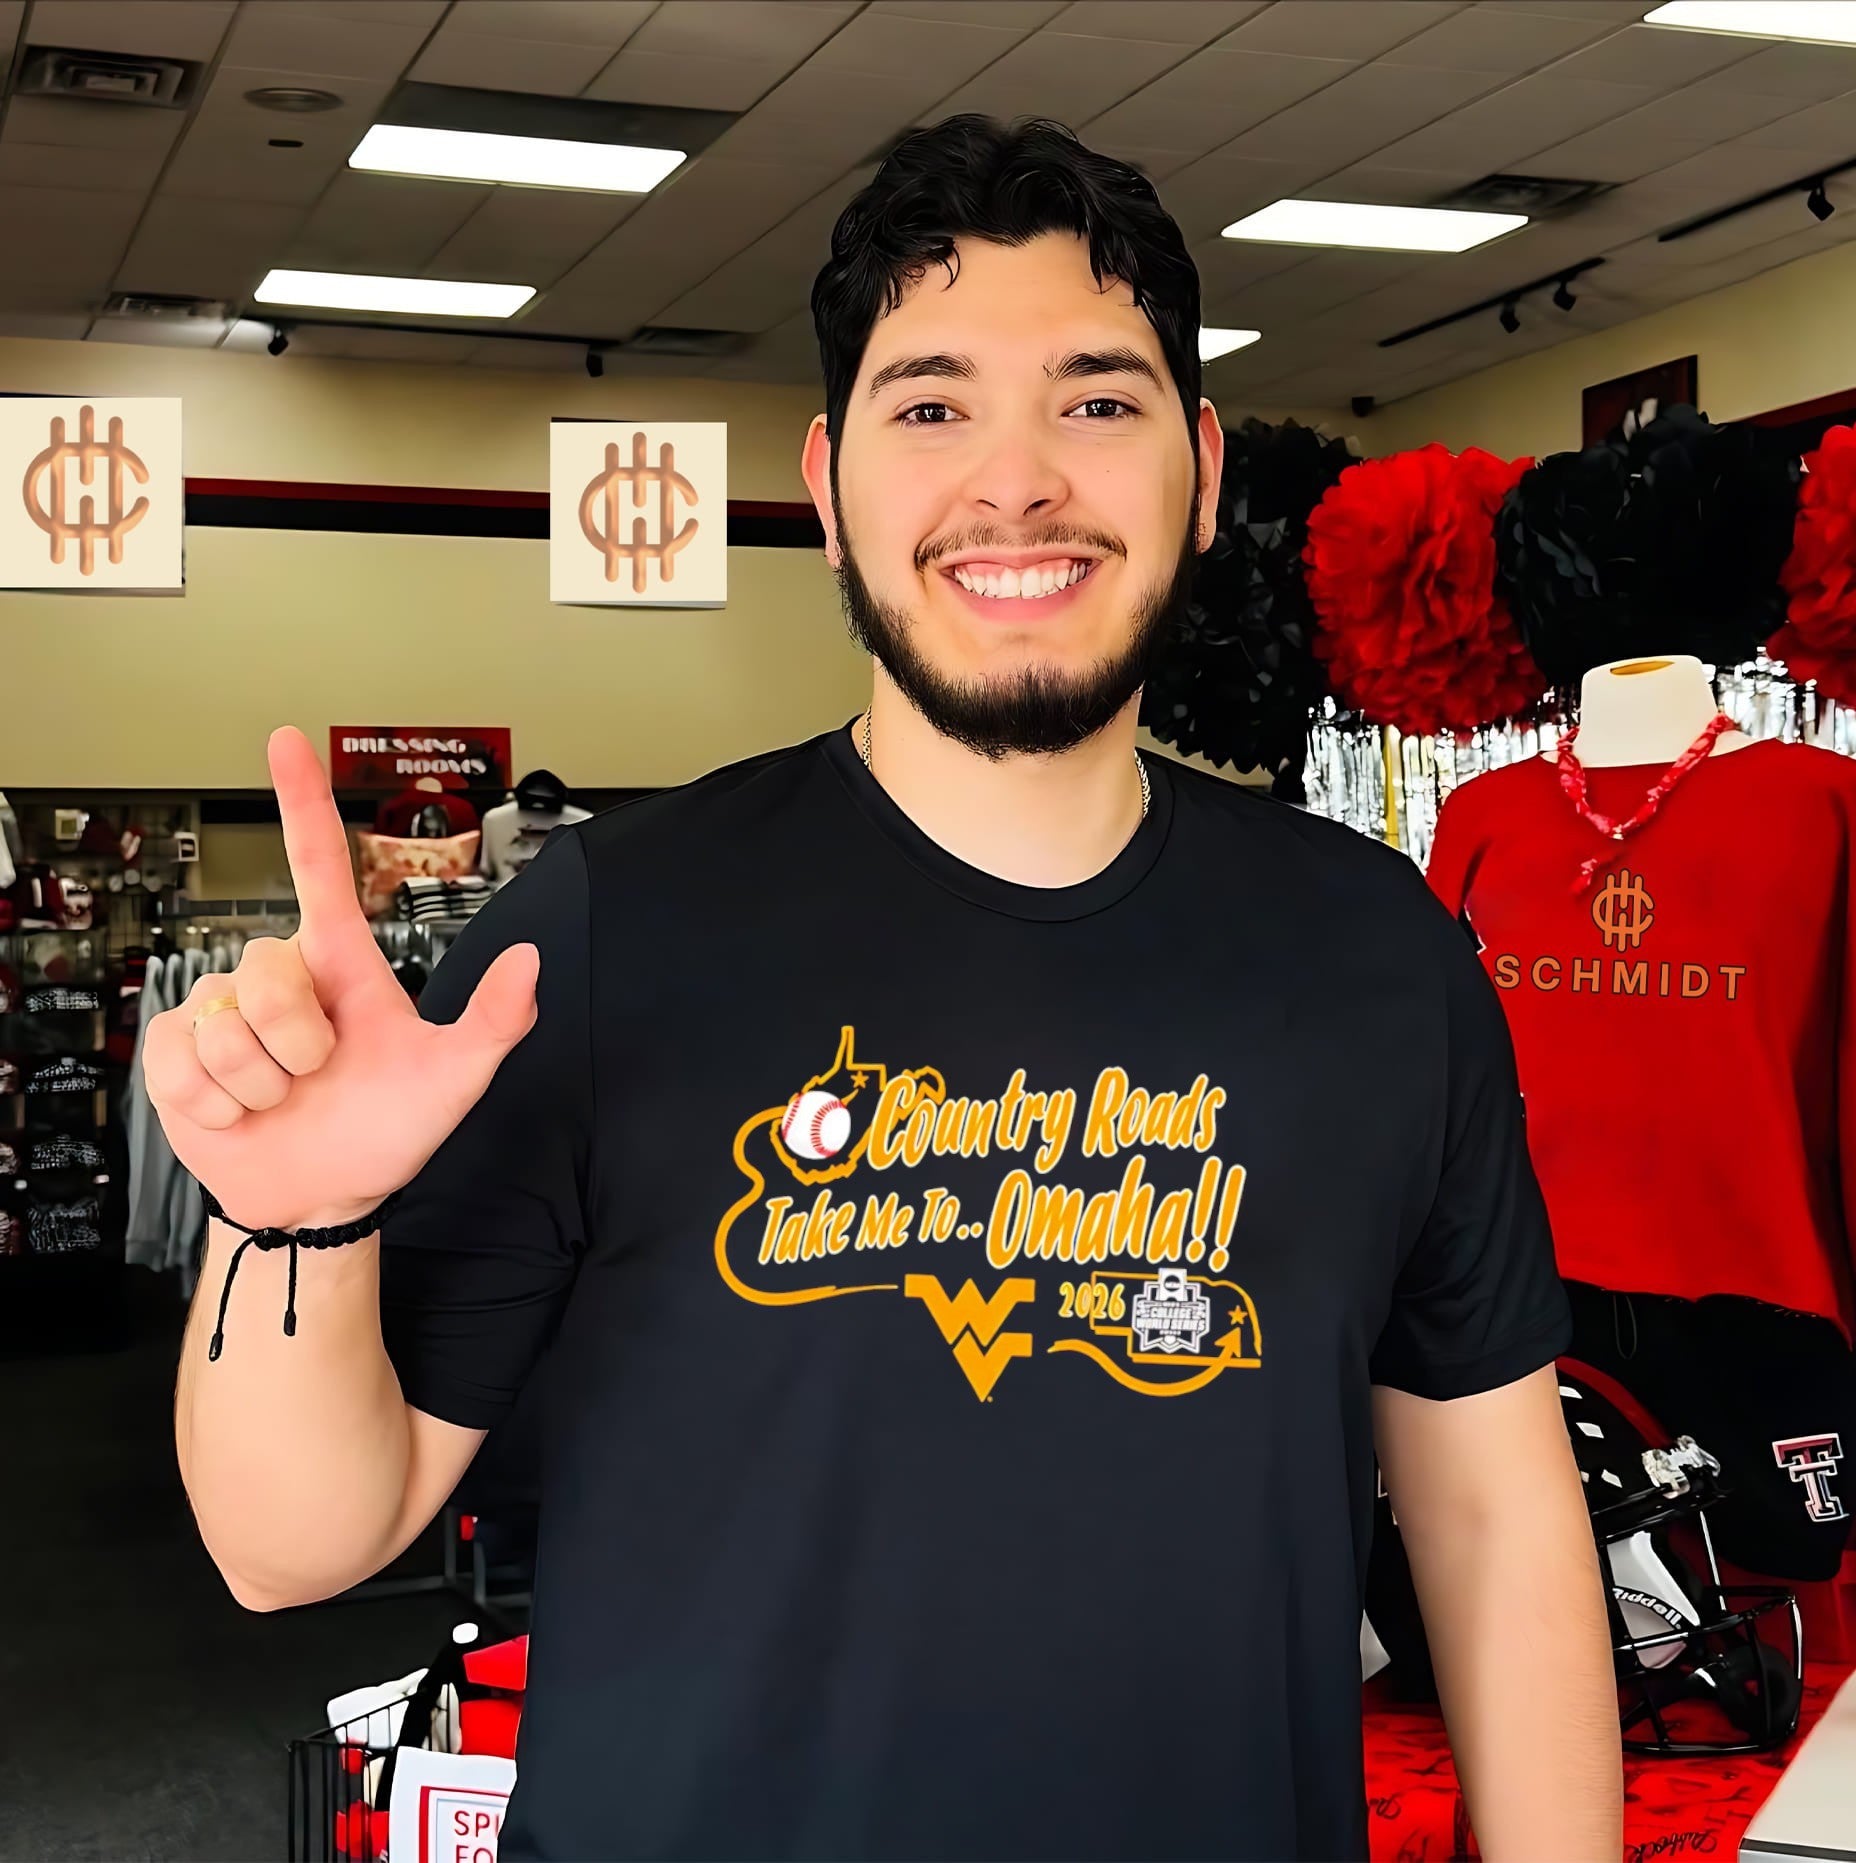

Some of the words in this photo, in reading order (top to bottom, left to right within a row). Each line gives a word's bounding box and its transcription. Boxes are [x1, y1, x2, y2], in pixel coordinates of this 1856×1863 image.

[396, 758, 487, 775] ROOMS
[1494, 954, 1747, 1000] SCHMIDT
[867, 1069, 1076, 1173] Country
[1083, 1067, 1227, 1158] Roads
[758, 1190, 856, 1265] Take
[856, 1192, 914, 1250] Me
[918, 1187, 984, 1243] To..
[986, 1155, 1247, 1272] Omaha!!
[1058, 1281, 1126, 1321] 2026
